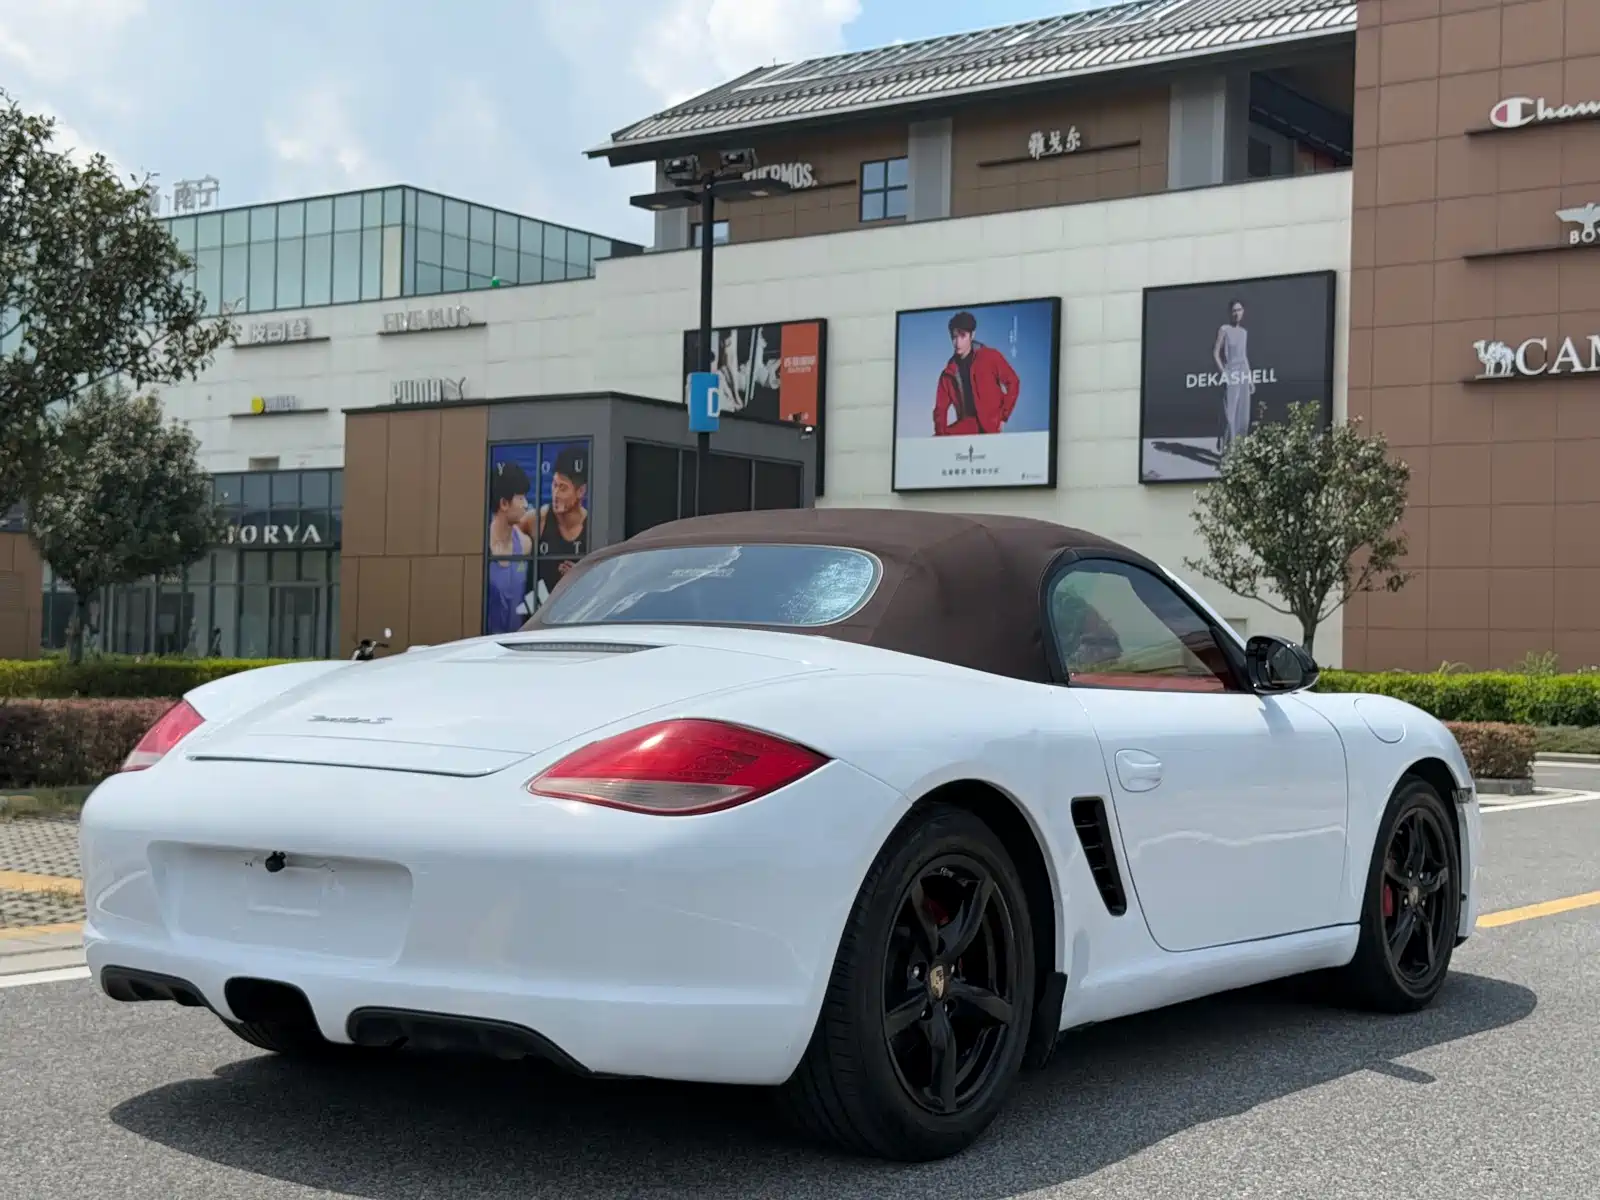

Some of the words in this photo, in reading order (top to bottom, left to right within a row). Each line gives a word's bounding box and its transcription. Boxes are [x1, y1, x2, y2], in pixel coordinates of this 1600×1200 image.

[1028, 125, 1081, 160] 雅戈尔
[1569, 227, 1600, 244] BO
[1185, 368, 1277, 389] DEKASHELL
[391, 379, 444, 404] PUMA
